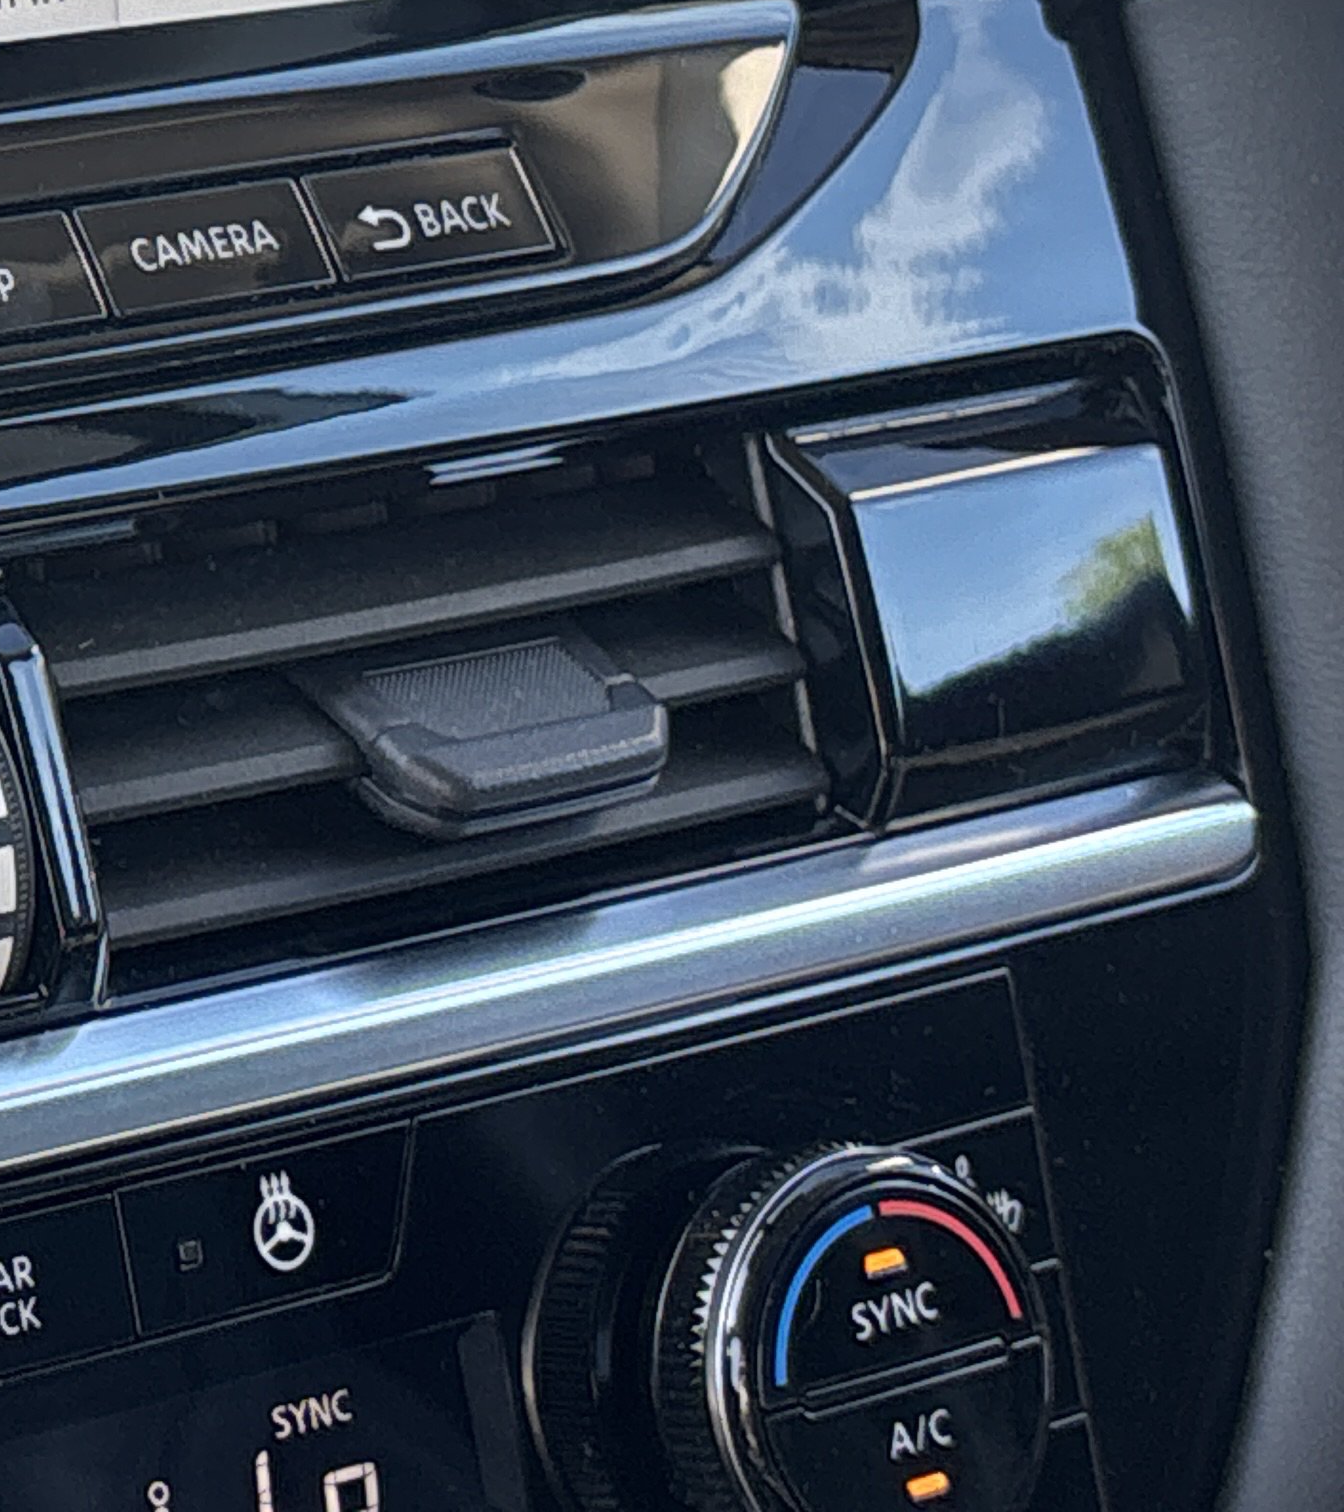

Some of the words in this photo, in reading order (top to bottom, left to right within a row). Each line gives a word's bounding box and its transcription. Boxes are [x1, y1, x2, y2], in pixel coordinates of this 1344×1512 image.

[413, 192, 512, 242] BACK
[129, 219, 280, 273] CAMERA
[850, 1281, 941, 1342] SYNC
[270, 1388, 354, 1440] SYNC
[889, 1407, 955, 1462] A/C
